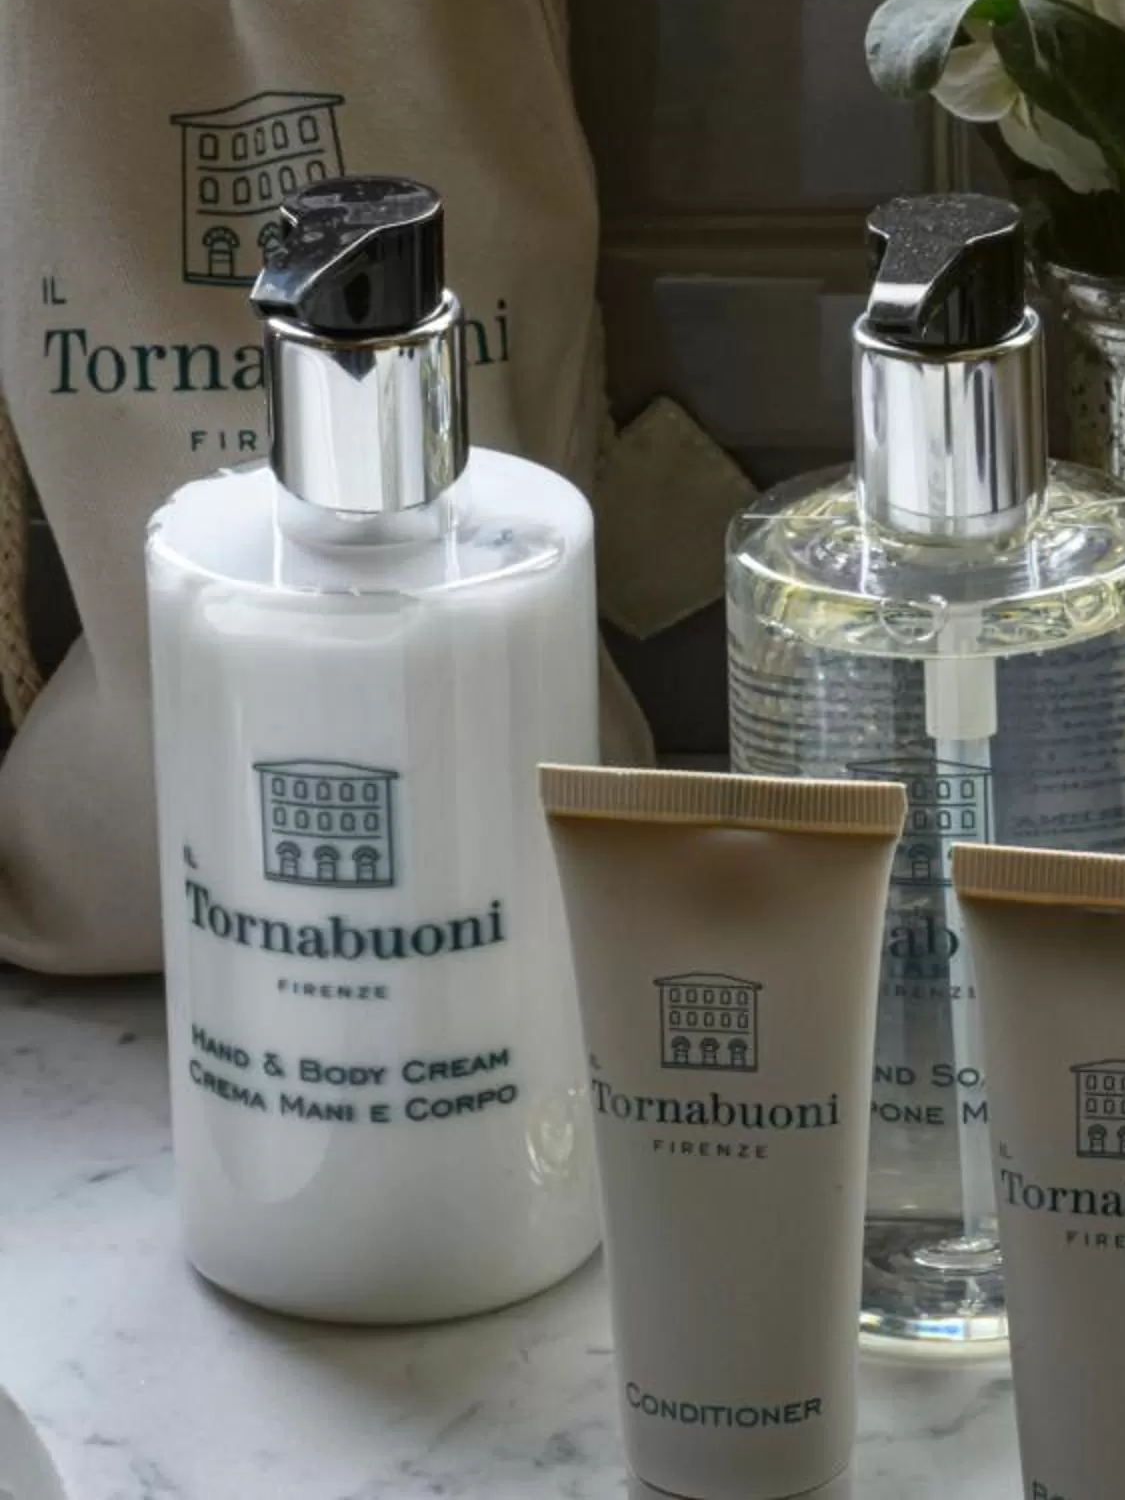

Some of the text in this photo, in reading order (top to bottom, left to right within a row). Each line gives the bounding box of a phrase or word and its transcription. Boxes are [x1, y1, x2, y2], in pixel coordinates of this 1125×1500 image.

[43, 276, 67, 305] IL
[44, 299, 512, 395] Tornani
[184, 878, 507, 962] Tornabuoni
[277, 978, 390, 1000] FIRENZE
[263, 1051, 286, 1079] &
[370, 1104, 391, 1124] E
[591, 1077, 841, 1131] Tornabuoni
[653, 1138, 769, 1160] FIRENZE
